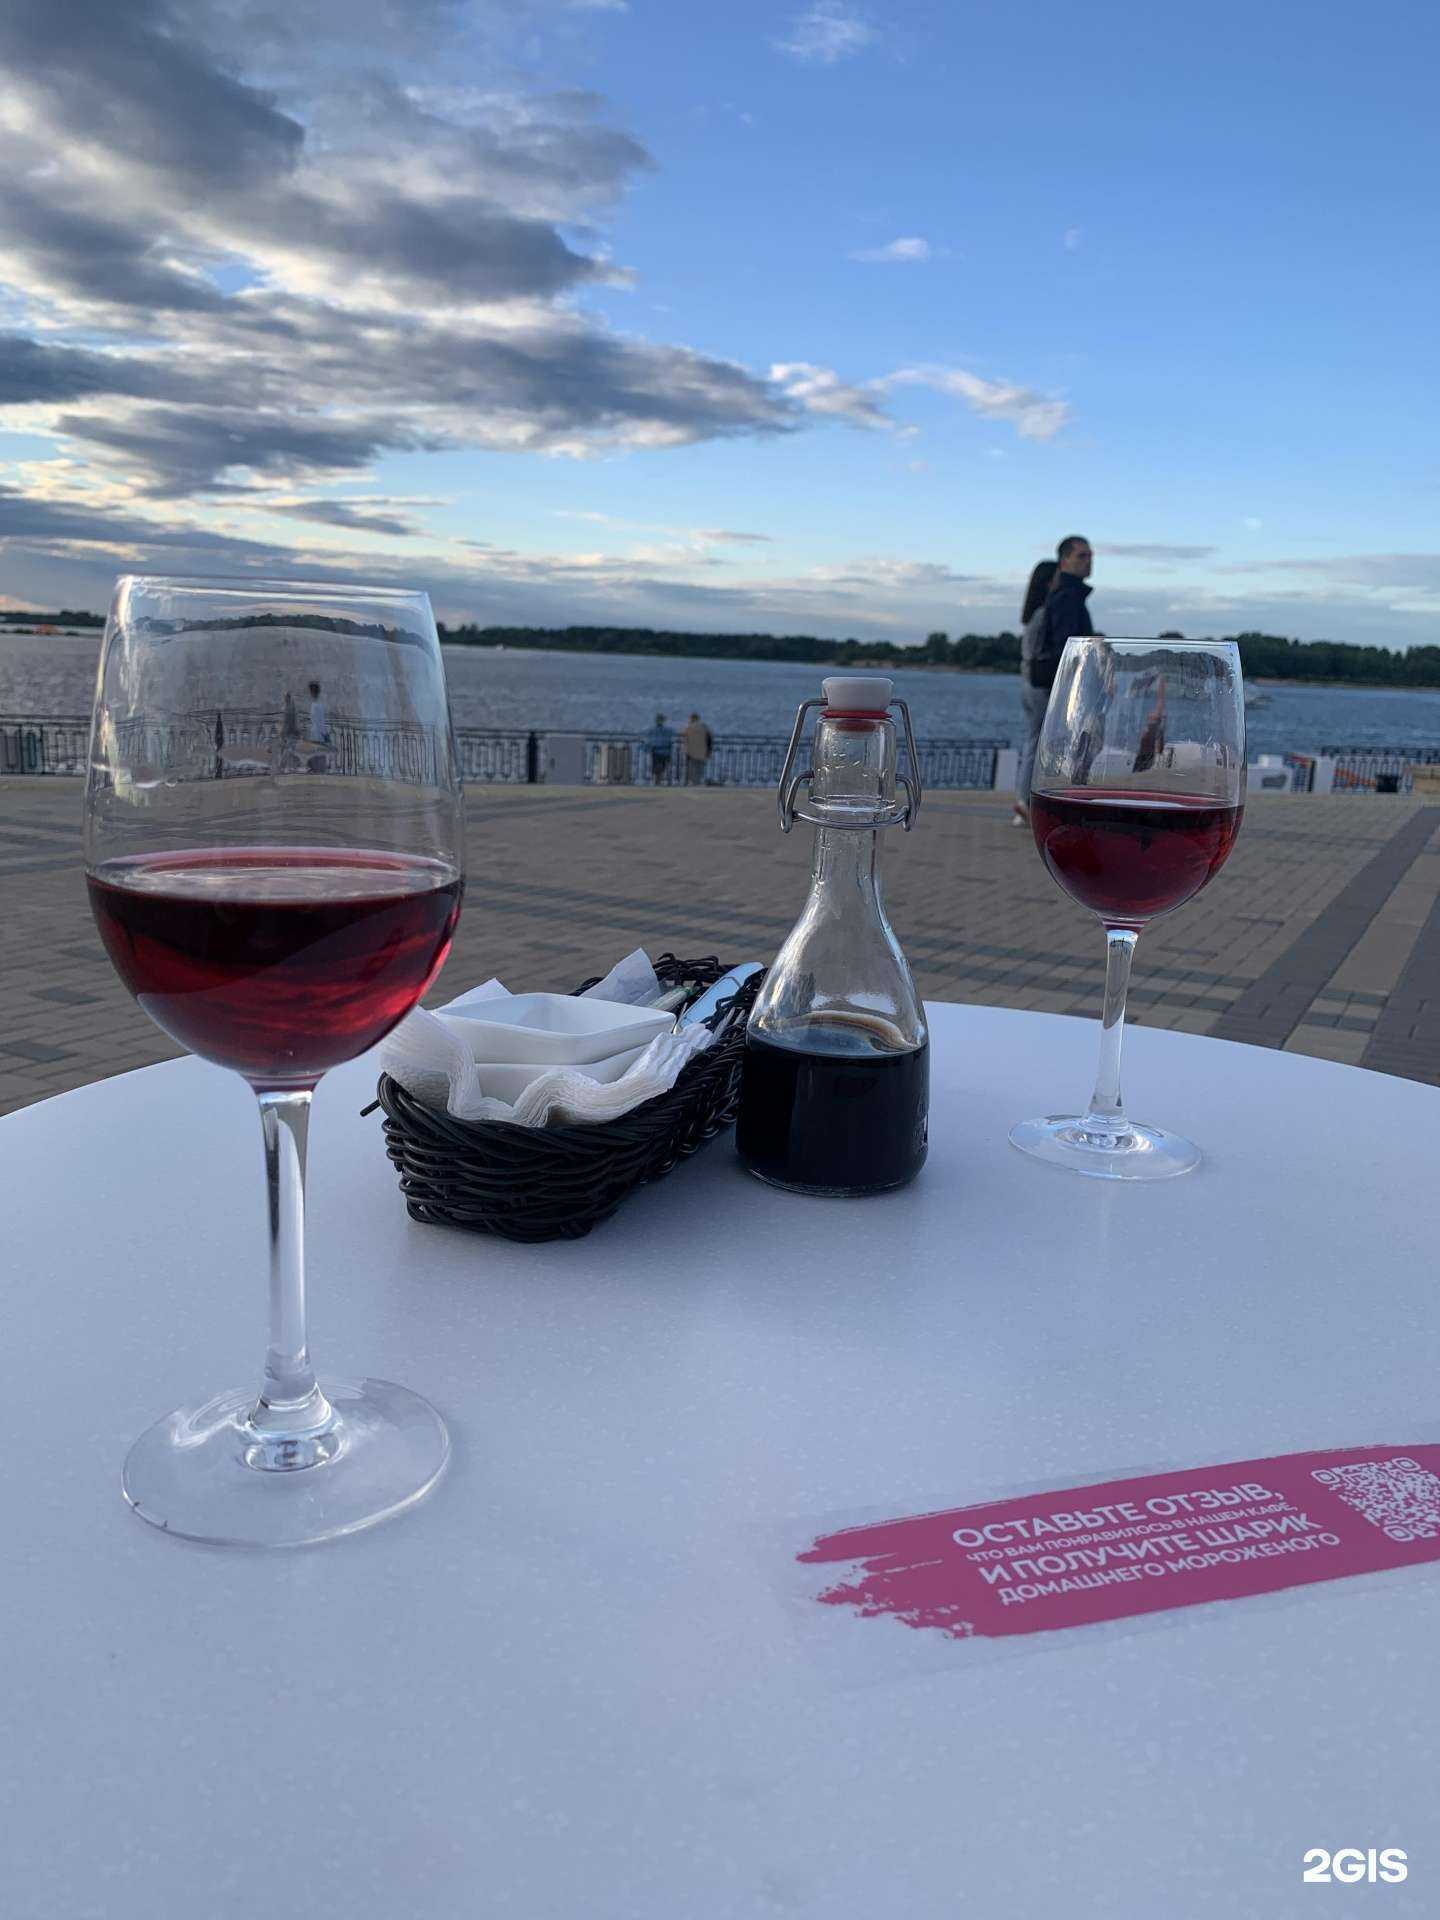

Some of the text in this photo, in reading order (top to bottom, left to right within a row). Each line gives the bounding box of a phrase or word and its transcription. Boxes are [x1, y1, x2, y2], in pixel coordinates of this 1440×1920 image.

[952, 1483, 1285, 1547] ОСТАВЬТЕ ОТЗЫВ,
[966, 1501, 1298, 1562] ЧТО ВАМ ПОНРАВИЛОСЬ В НАШЕМ КАФЕ,
[978, 1513, 1324, 1585] И ПОЛУЧИТЕ ШАРИК
[998, 1532, 1341, 1606] ДОМАШНЕГО МОРОЖЕНОГО
